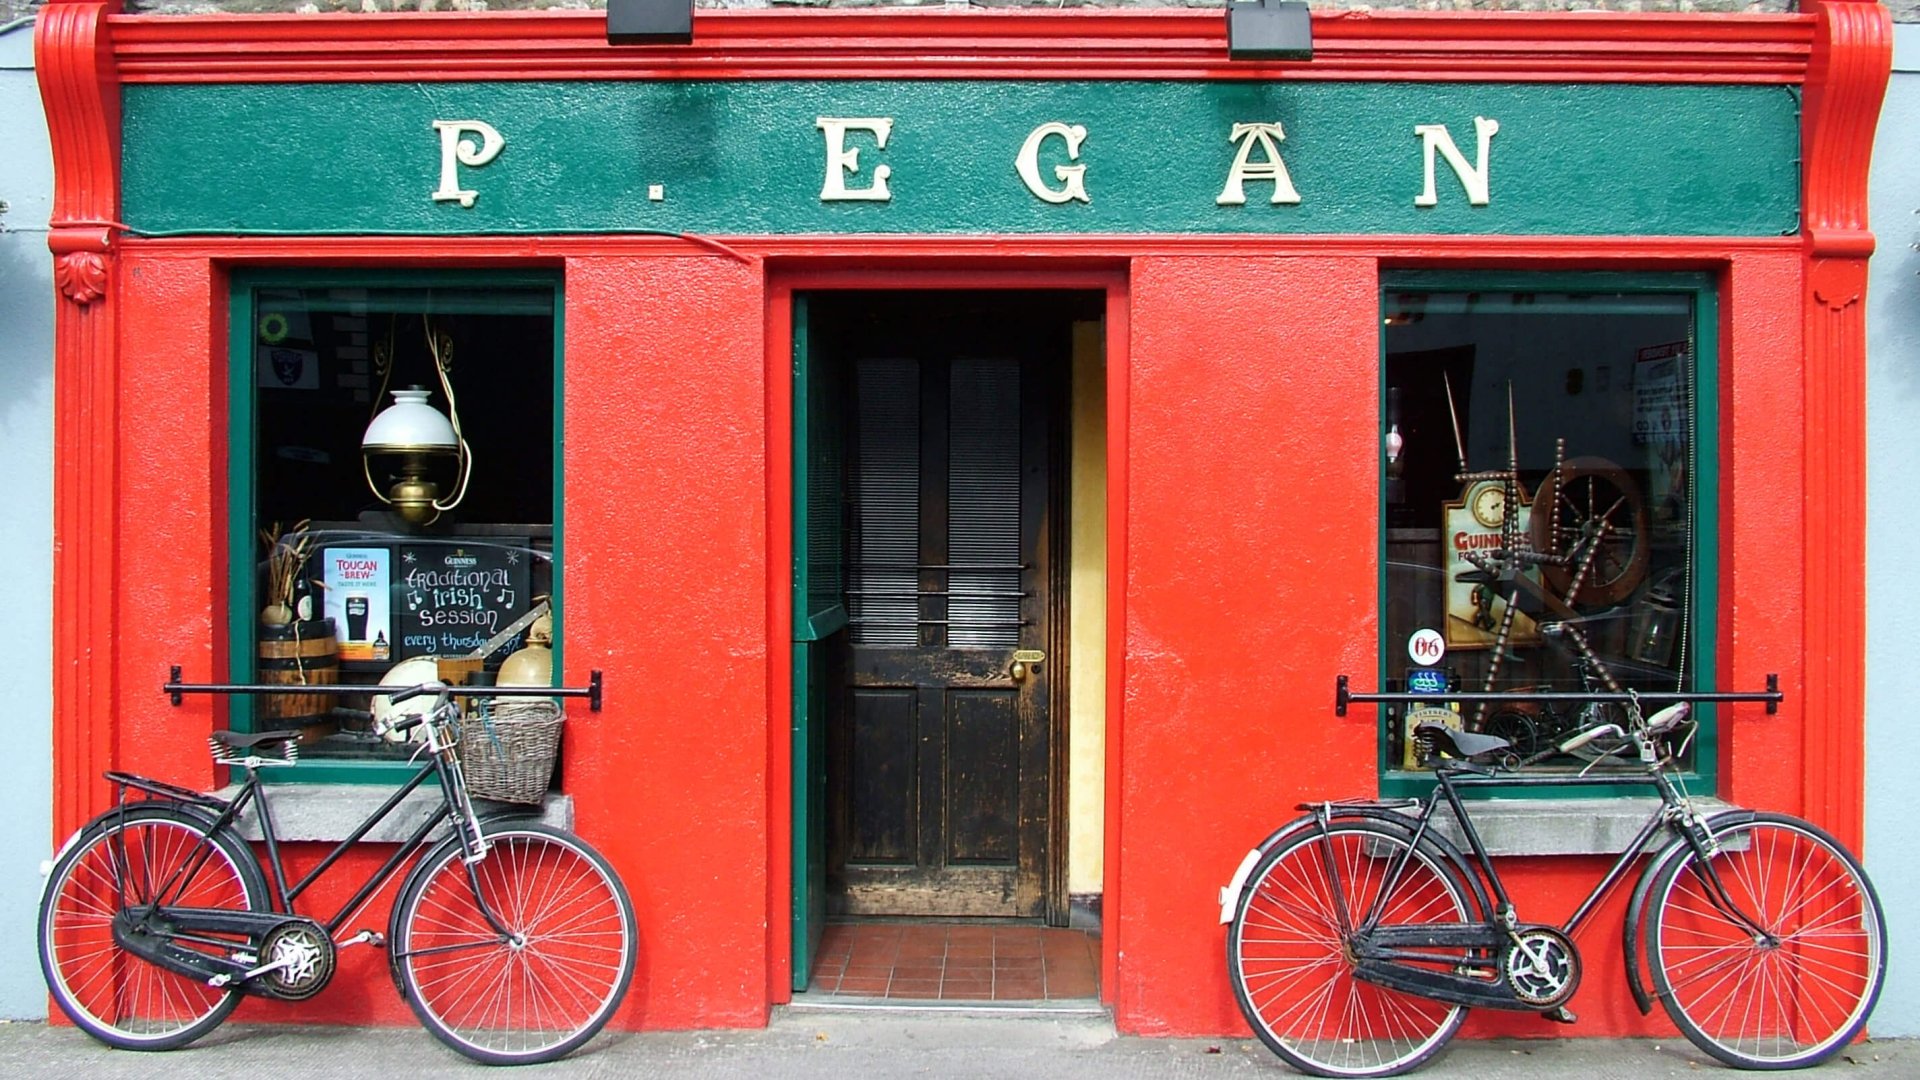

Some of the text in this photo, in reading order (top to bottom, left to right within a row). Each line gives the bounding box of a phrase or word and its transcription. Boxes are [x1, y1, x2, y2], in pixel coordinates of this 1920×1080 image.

[815, 116, 1500, 207] EGAN
[1454, 531, 1532, 550] GUINNS
[336, 559, 377, 571] TOUCAN
[444, 556, 477, 565] GUINNESS
[404, 632, 437, 653] every
